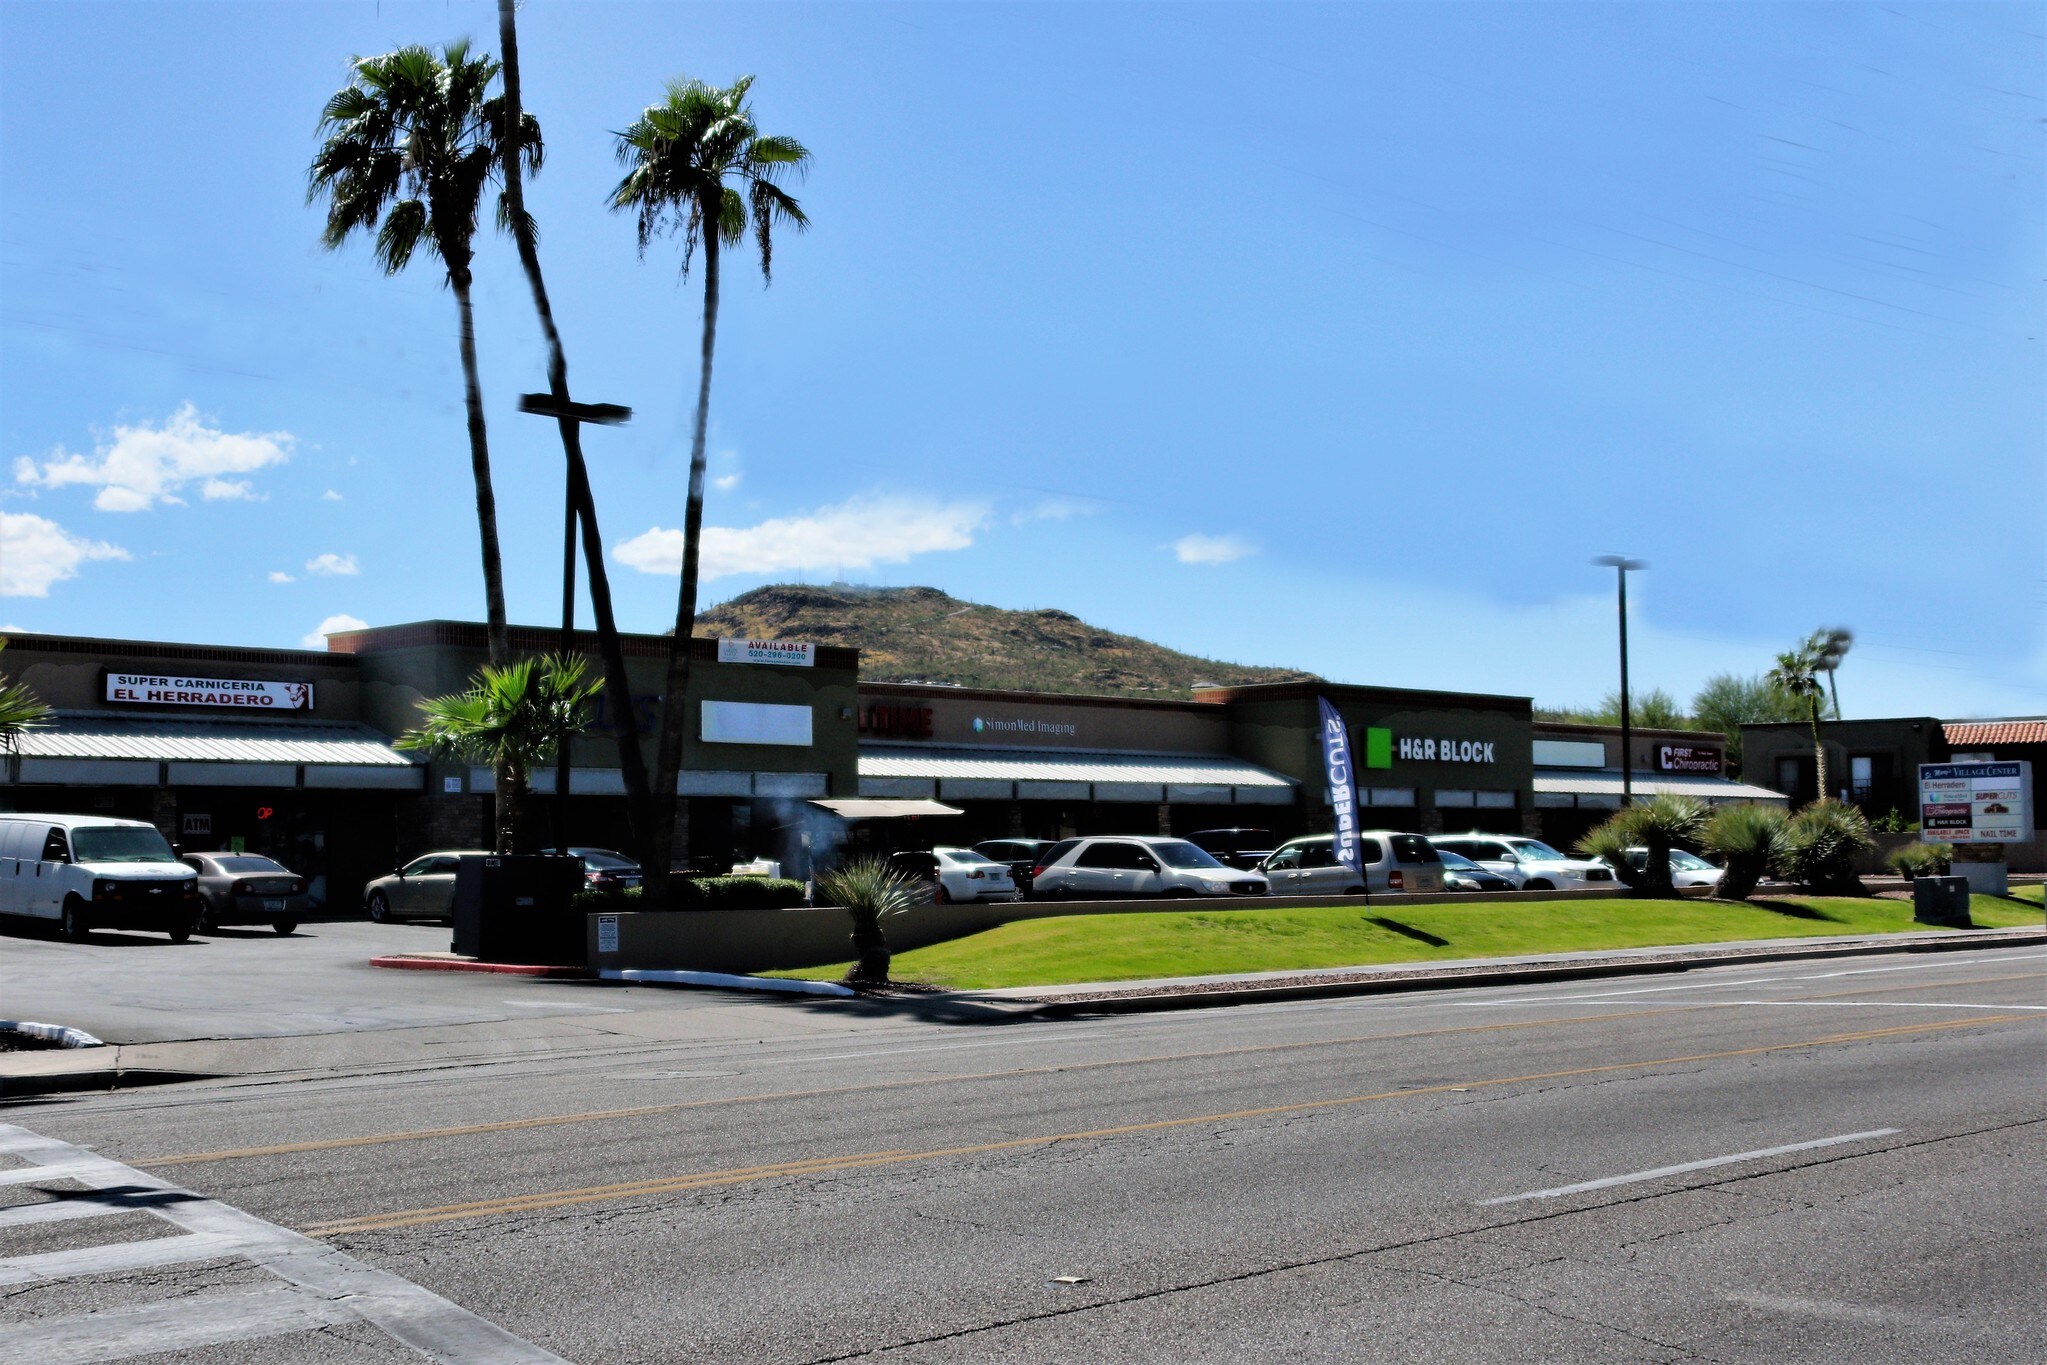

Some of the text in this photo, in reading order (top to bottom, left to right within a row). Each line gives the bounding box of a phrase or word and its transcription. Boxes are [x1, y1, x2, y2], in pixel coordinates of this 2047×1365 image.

[748, 641, 807, 652] AVAILABLE
[748, 650, 806, 660] 520-296-0200
[118, 676, 266, 691] SUPER CARNICERIA
[114, 689, 274, 706] EL HERRADERO
[985, 718, 1076, 736] SimonMed Imaging
[1400, 738, 1494, 763] H&R BLOCK
[1674, 748, 1693, 757] FIRST
[1674, 757, 1719, 770] Chiropractic
[1987, 766, 2017, 777] CENTER
[1976, 792, 2017, 800] SUPERCUTS
[185, 818, 210, 831] ATM
